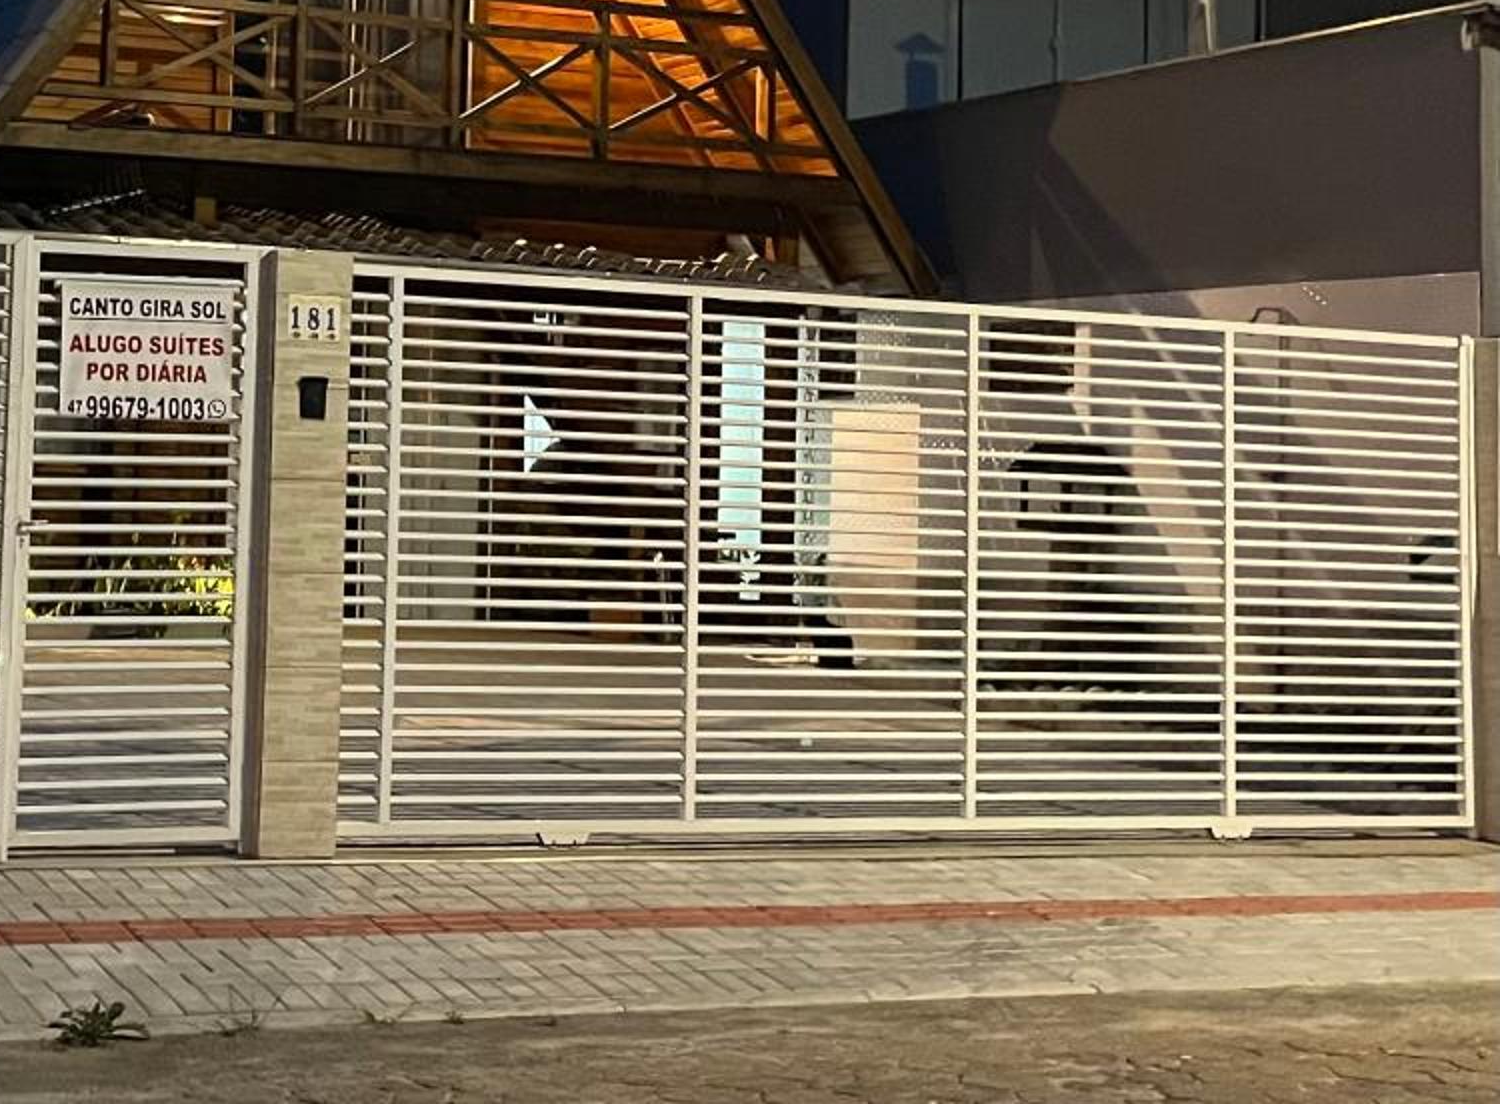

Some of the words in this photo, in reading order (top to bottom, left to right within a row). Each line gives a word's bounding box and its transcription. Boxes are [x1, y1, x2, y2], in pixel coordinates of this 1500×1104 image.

[69, 297, 133, 317] CANTO
[140, 299, 185, 318] GIRA
[191, 301, 227, 320] SOL
[291, 305, 336, 331] 181
[69, 335, 143, 354] ALUGO
[149, 333, 225, 356] SUÍTES
[86, 363, 130, 382] POR
[136, 362, 207, 383] DIÁRIA
[67, 399, 83, 413] 47
[86, 396, 205, 419] 99679-1003
